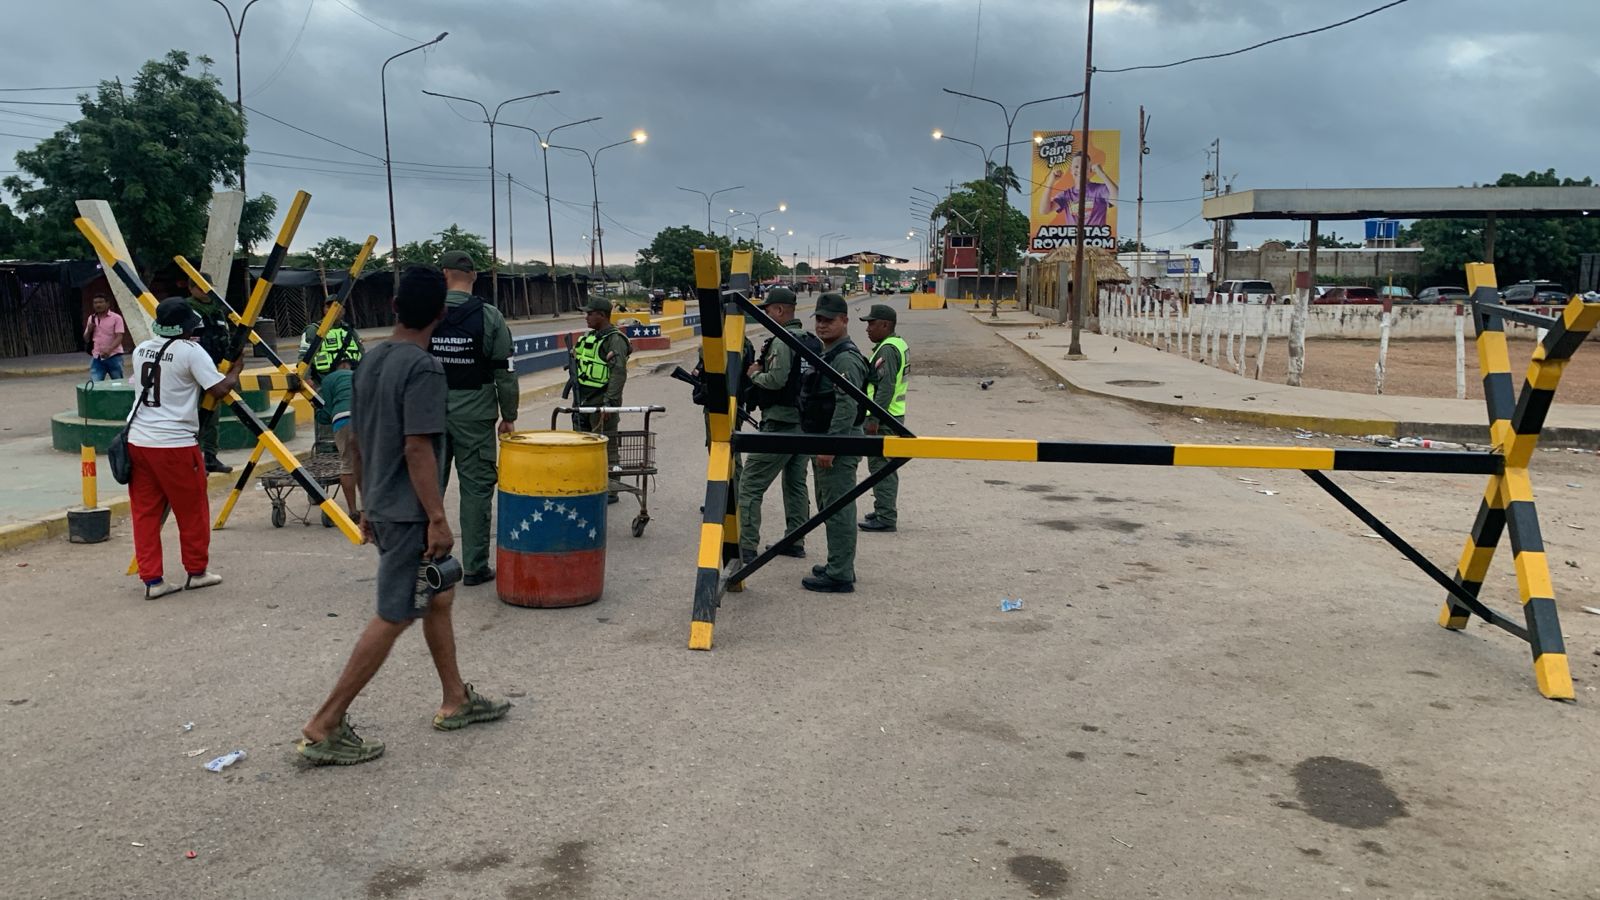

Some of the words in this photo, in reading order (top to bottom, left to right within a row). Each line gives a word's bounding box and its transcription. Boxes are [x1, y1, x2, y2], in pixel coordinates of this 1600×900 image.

[1040, 144, 1072, 158] Gana
[1048, 152, 1067, 167] ya!
[1038, 226, 1110, 237] APUETAS
[1033, 238, 1114, 249] ROYALCOM
[436, 356, 475, 364] OLIVARIANA
